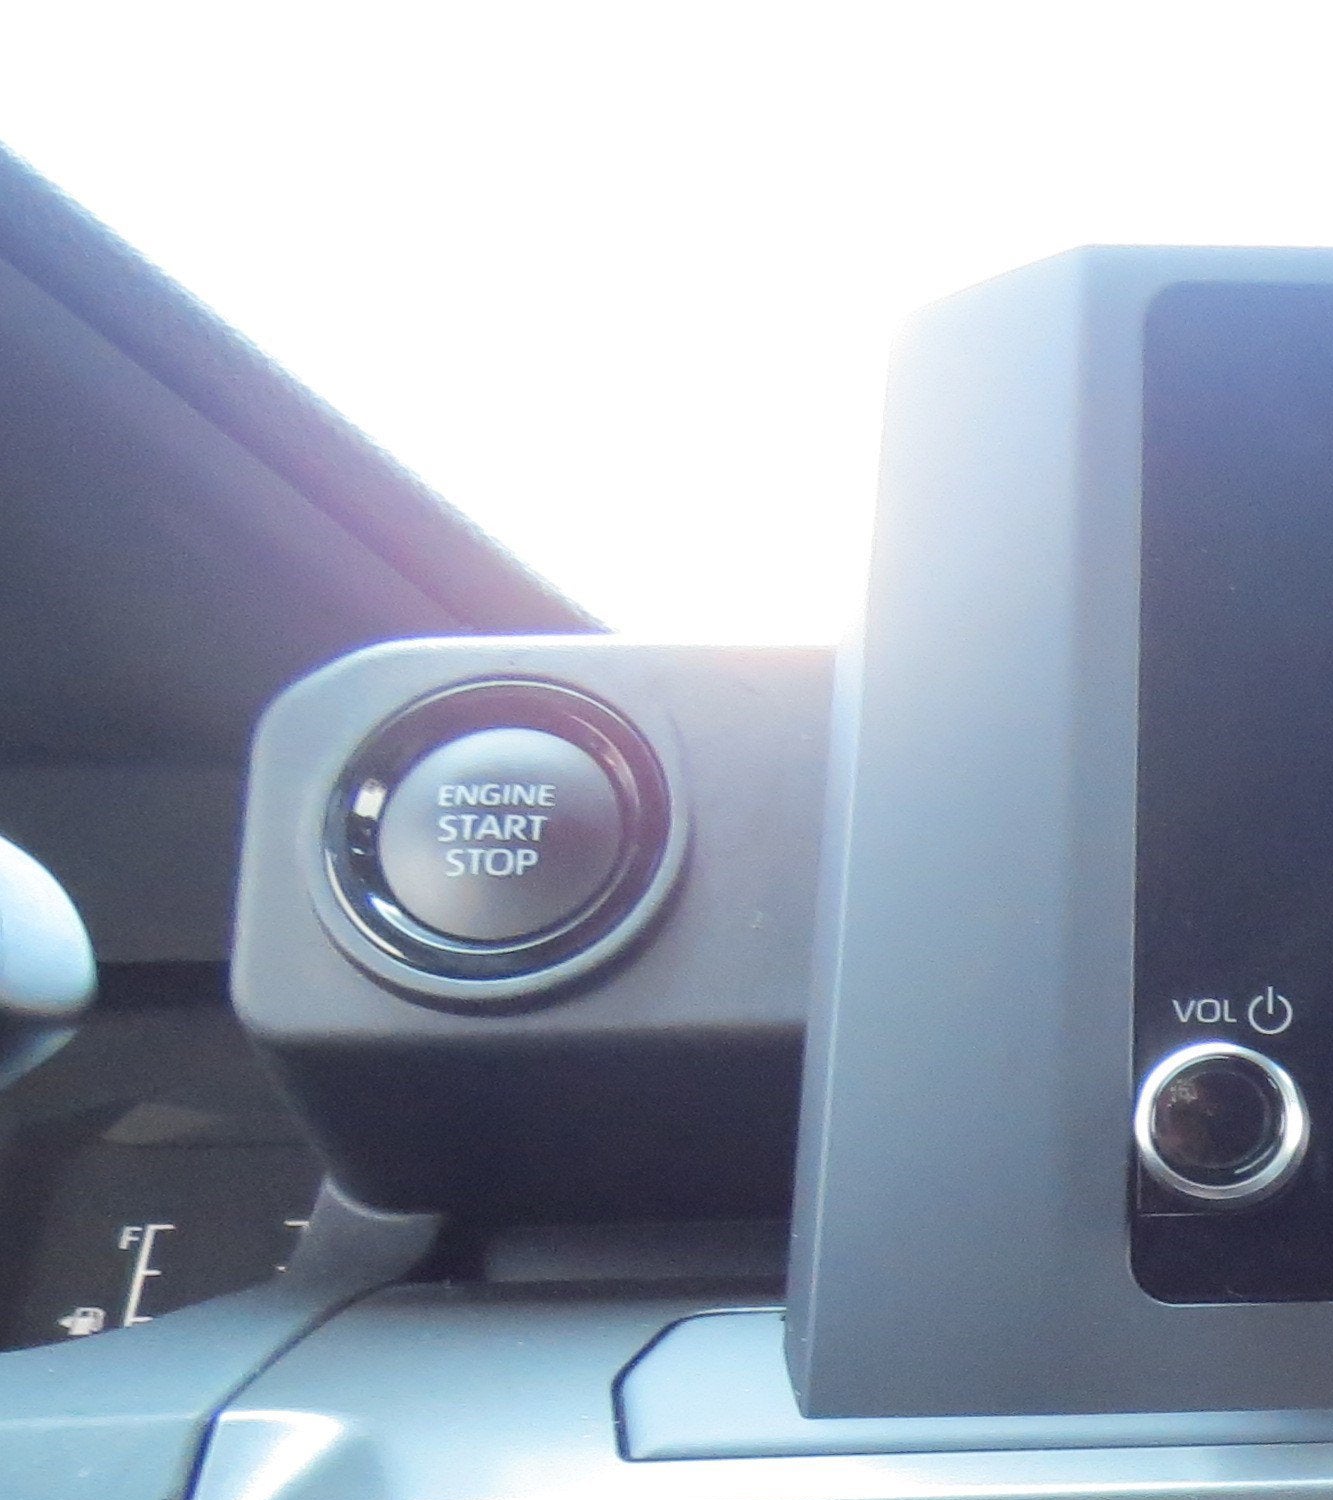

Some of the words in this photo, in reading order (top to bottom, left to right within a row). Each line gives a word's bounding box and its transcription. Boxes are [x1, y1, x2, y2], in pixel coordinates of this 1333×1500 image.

[437, 783, 557, 808] ENGINE
[436, 814, 549, 843] START
[444, 847, 540, 878] STOP
[1172, 998, 1237, 1023] VOL
[118, 1225, 142, 1250] F
